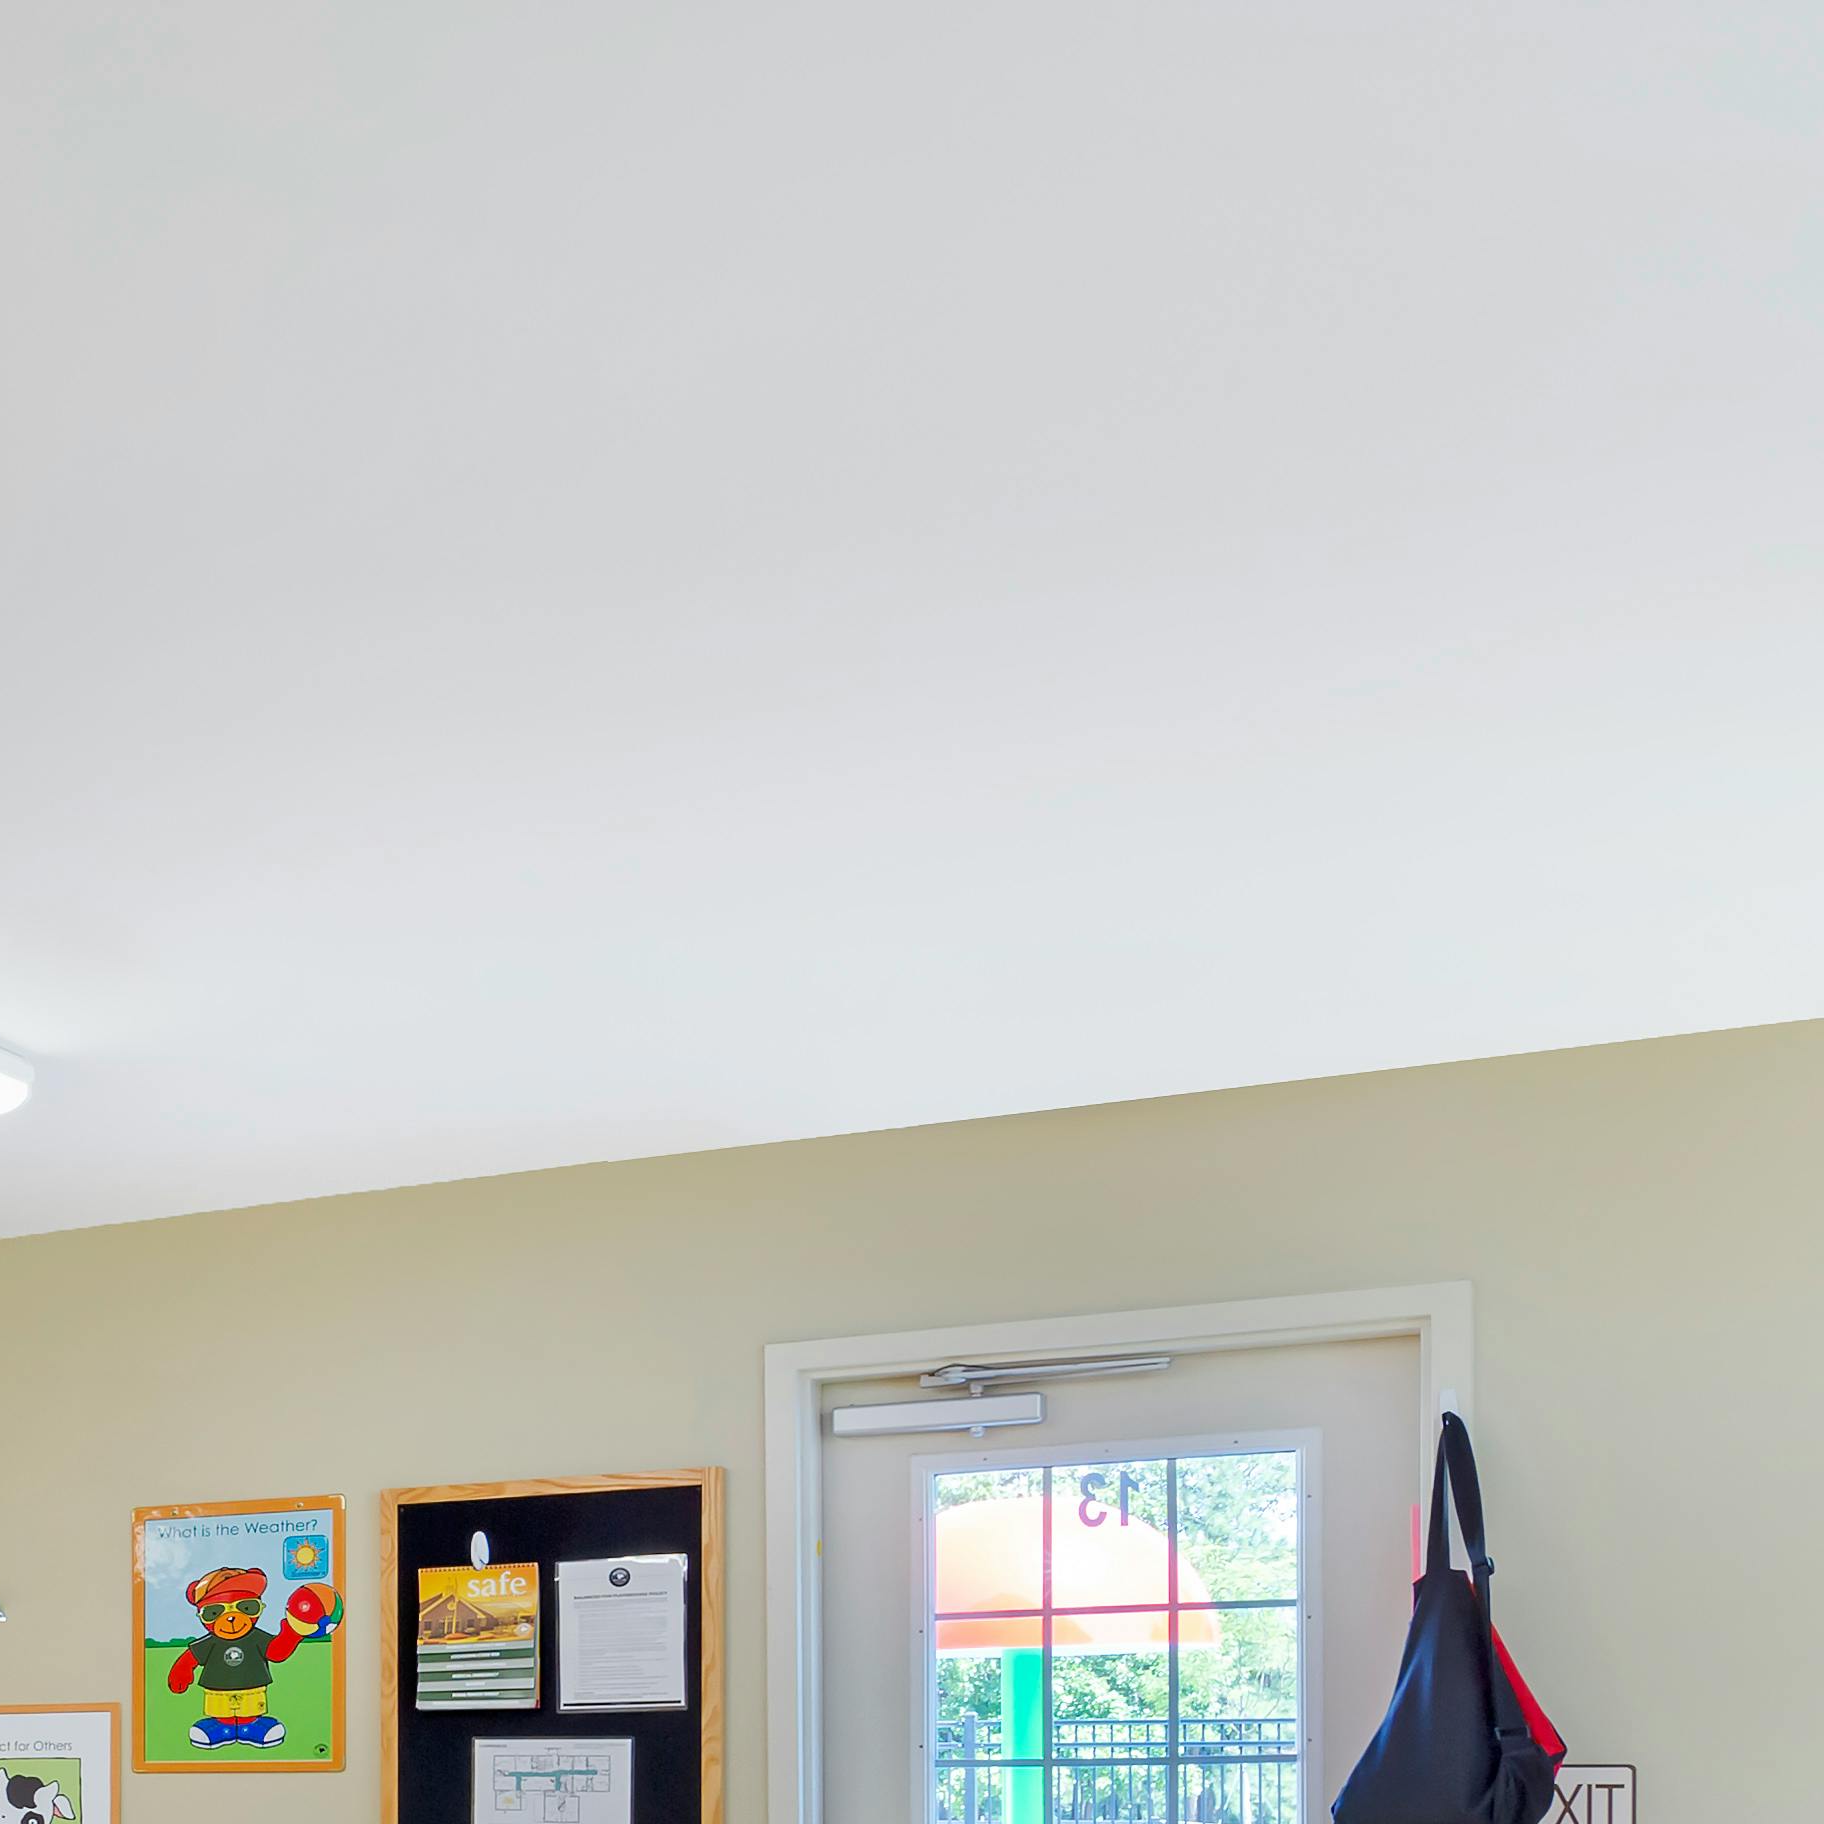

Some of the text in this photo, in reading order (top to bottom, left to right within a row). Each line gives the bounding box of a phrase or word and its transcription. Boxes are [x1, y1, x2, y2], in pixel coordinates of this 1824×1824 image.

[159, 1518, 318, 1539] What is the Weather?
[467, 1570, 527, 1598] safe
[14, 1741, 31, 1752] for
[33, 1740, 73, 1752] Others
